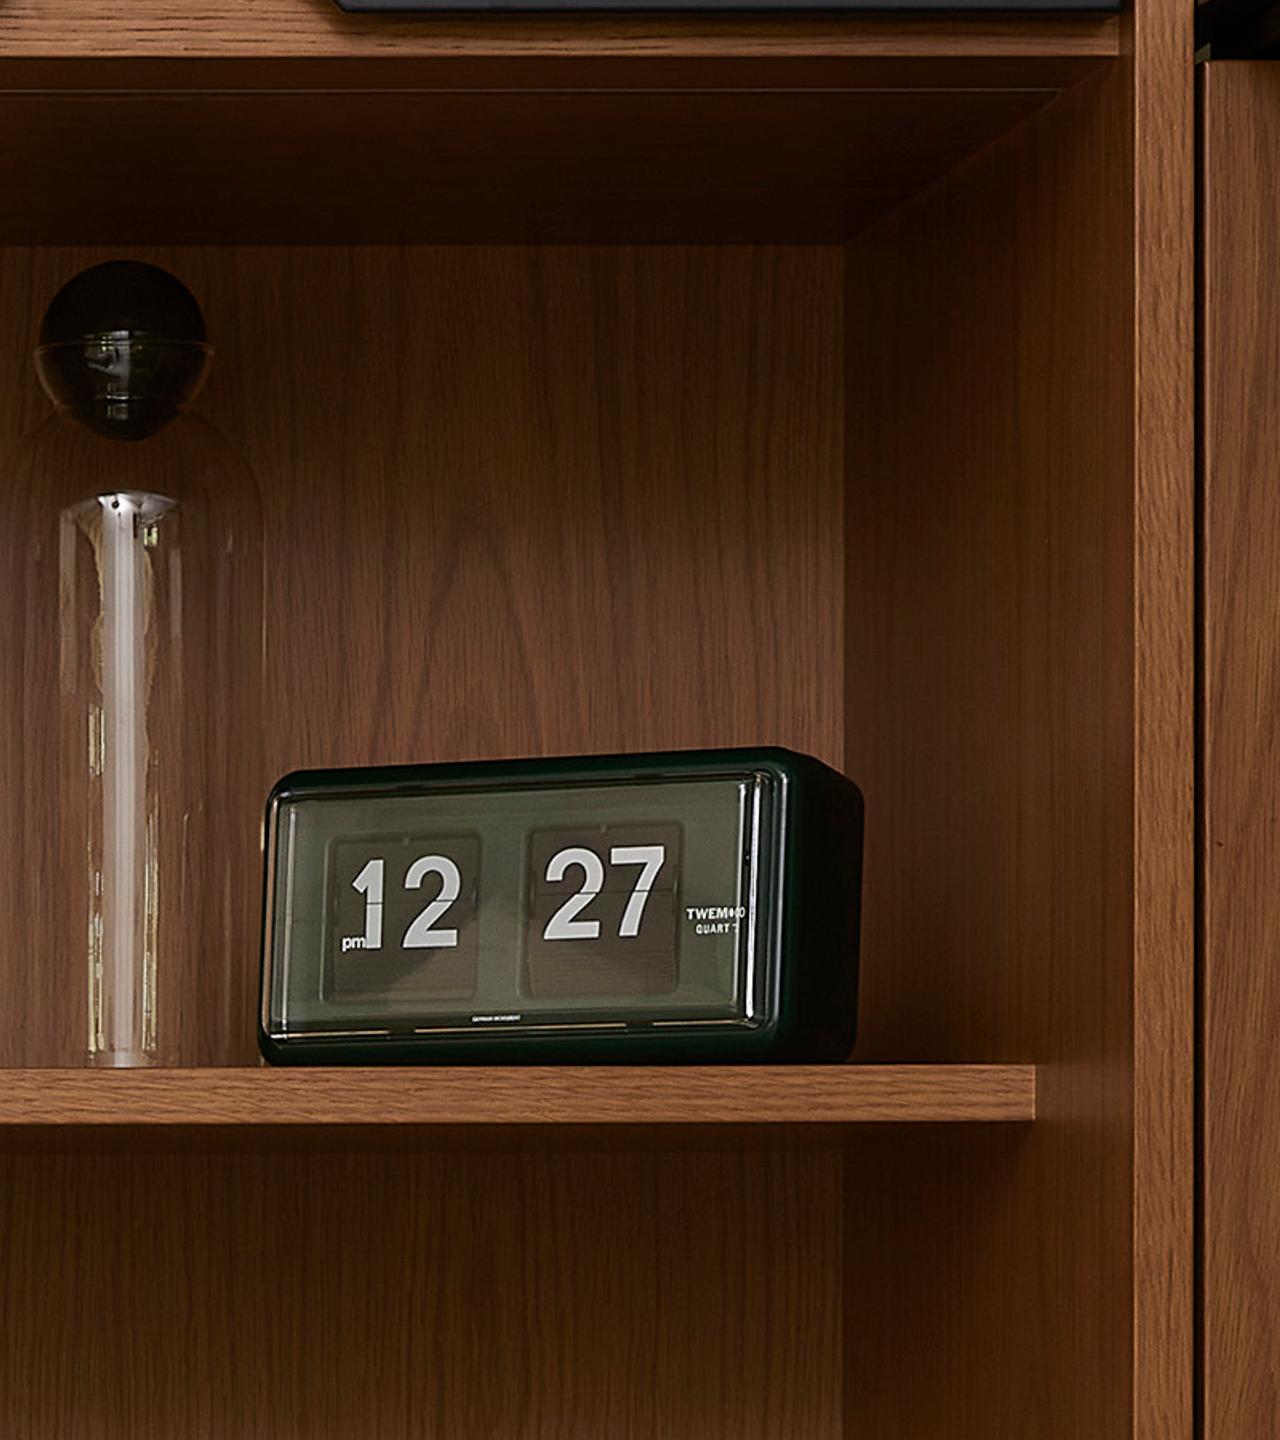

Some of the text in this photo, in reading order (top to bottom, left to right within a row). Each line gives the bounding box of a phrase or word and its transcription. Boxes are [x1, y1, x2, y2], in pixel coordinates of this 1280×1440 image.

[352, 846, 665, 949] 12 27
[342, 937, 367, 952] pm
